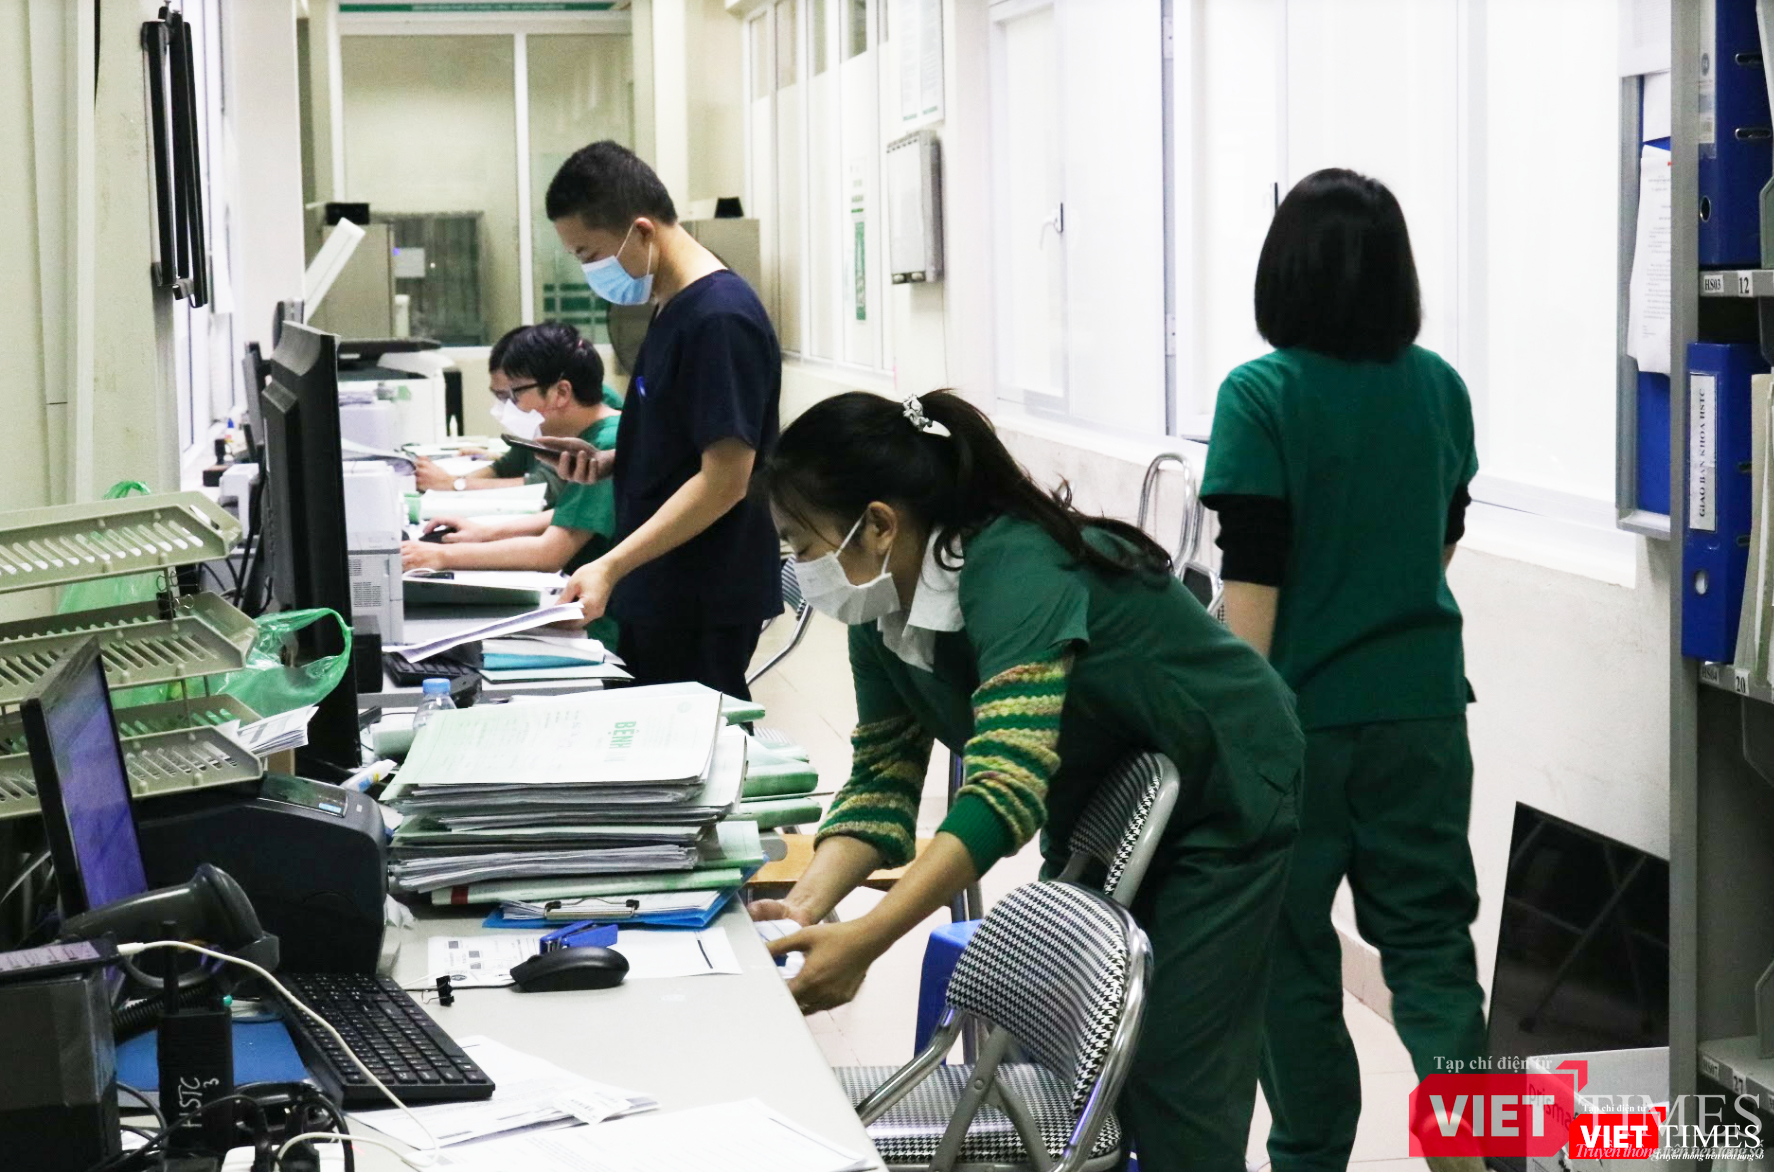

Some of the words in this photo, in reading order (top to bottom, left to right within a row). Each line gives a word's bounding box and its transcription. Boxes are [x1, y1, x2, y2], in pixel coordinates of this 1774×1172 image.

[1704, 278, 1721, 291] HS03
[1739, 276, 1749, 294] 12
[1698, 388, 1706, 420] HSTC
[1698, 423, 1706, 457] KHOA
[1698, 486, 1706, 518] GIAO
[1736, 675, 1746, 694] 20
[607, 721, 640, 750] BỆNH
[202, 1077, 220, 1088] 3
[1733, 1075, 1744, 1094] 27
[177, 1076, 203, 1128] HSTC
